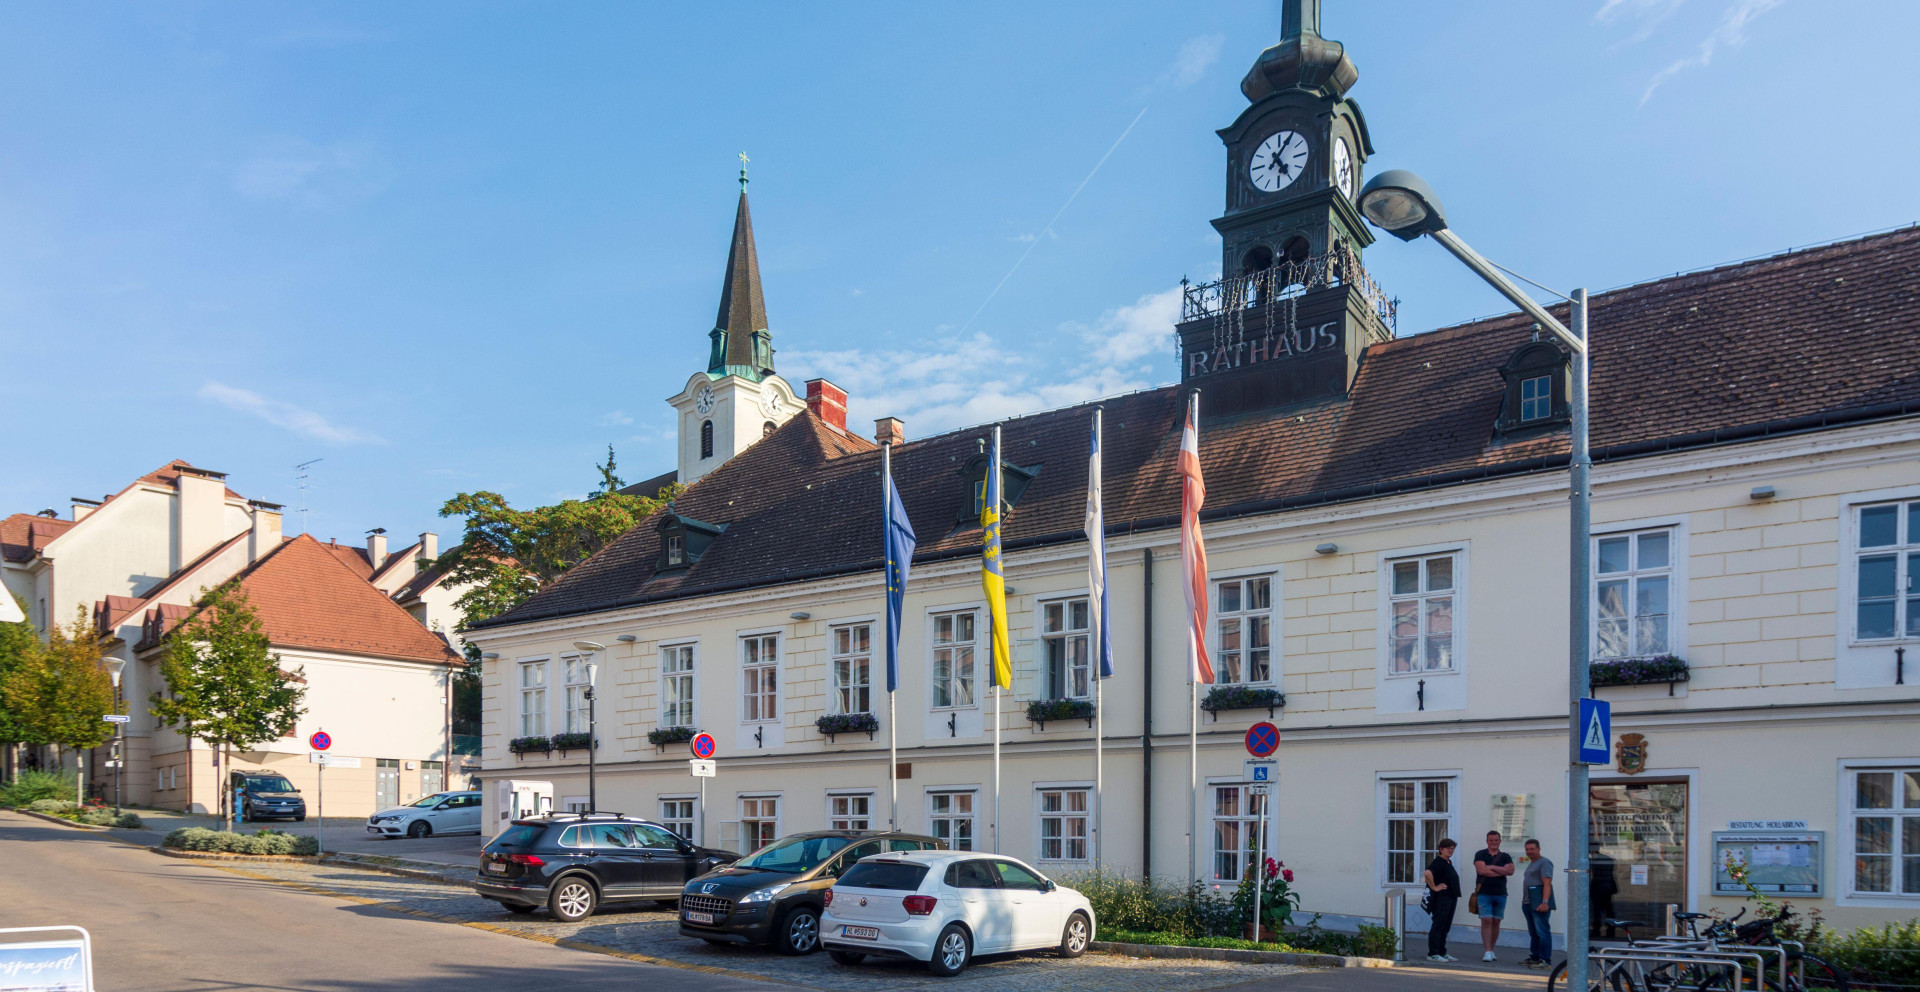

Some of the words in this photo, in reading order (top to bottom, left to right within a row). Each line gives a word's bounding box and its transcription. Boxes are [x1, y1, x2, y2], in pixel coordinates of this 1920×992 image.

[1189, 321, 1337, 376] RATHAUS
[1730, 821, 1764, 829] BESTATTUNG
[1766, 821, 1805, 829] HOLLABRUNN
